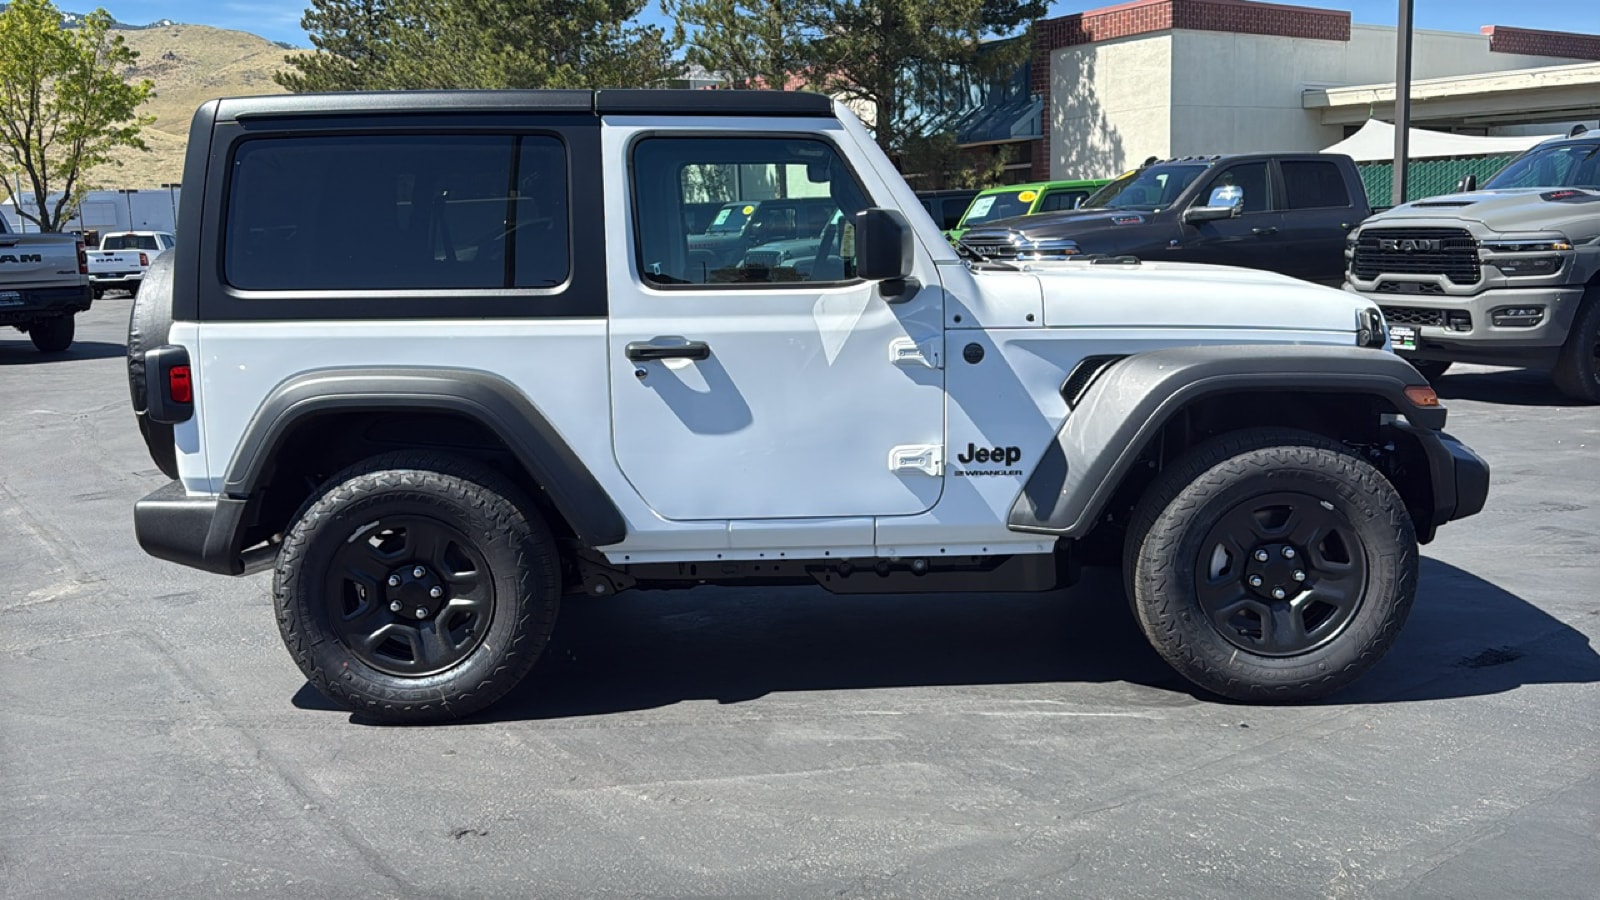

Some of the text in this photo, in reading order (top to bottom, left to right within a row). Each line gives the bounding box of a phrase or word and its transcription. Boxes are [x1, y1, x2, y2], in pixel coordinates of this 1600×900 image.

[1379, 239, 1441, 250] RAM
[0, 254, 42, 263] AM
[957, 442, 1021, 466] Jeep
